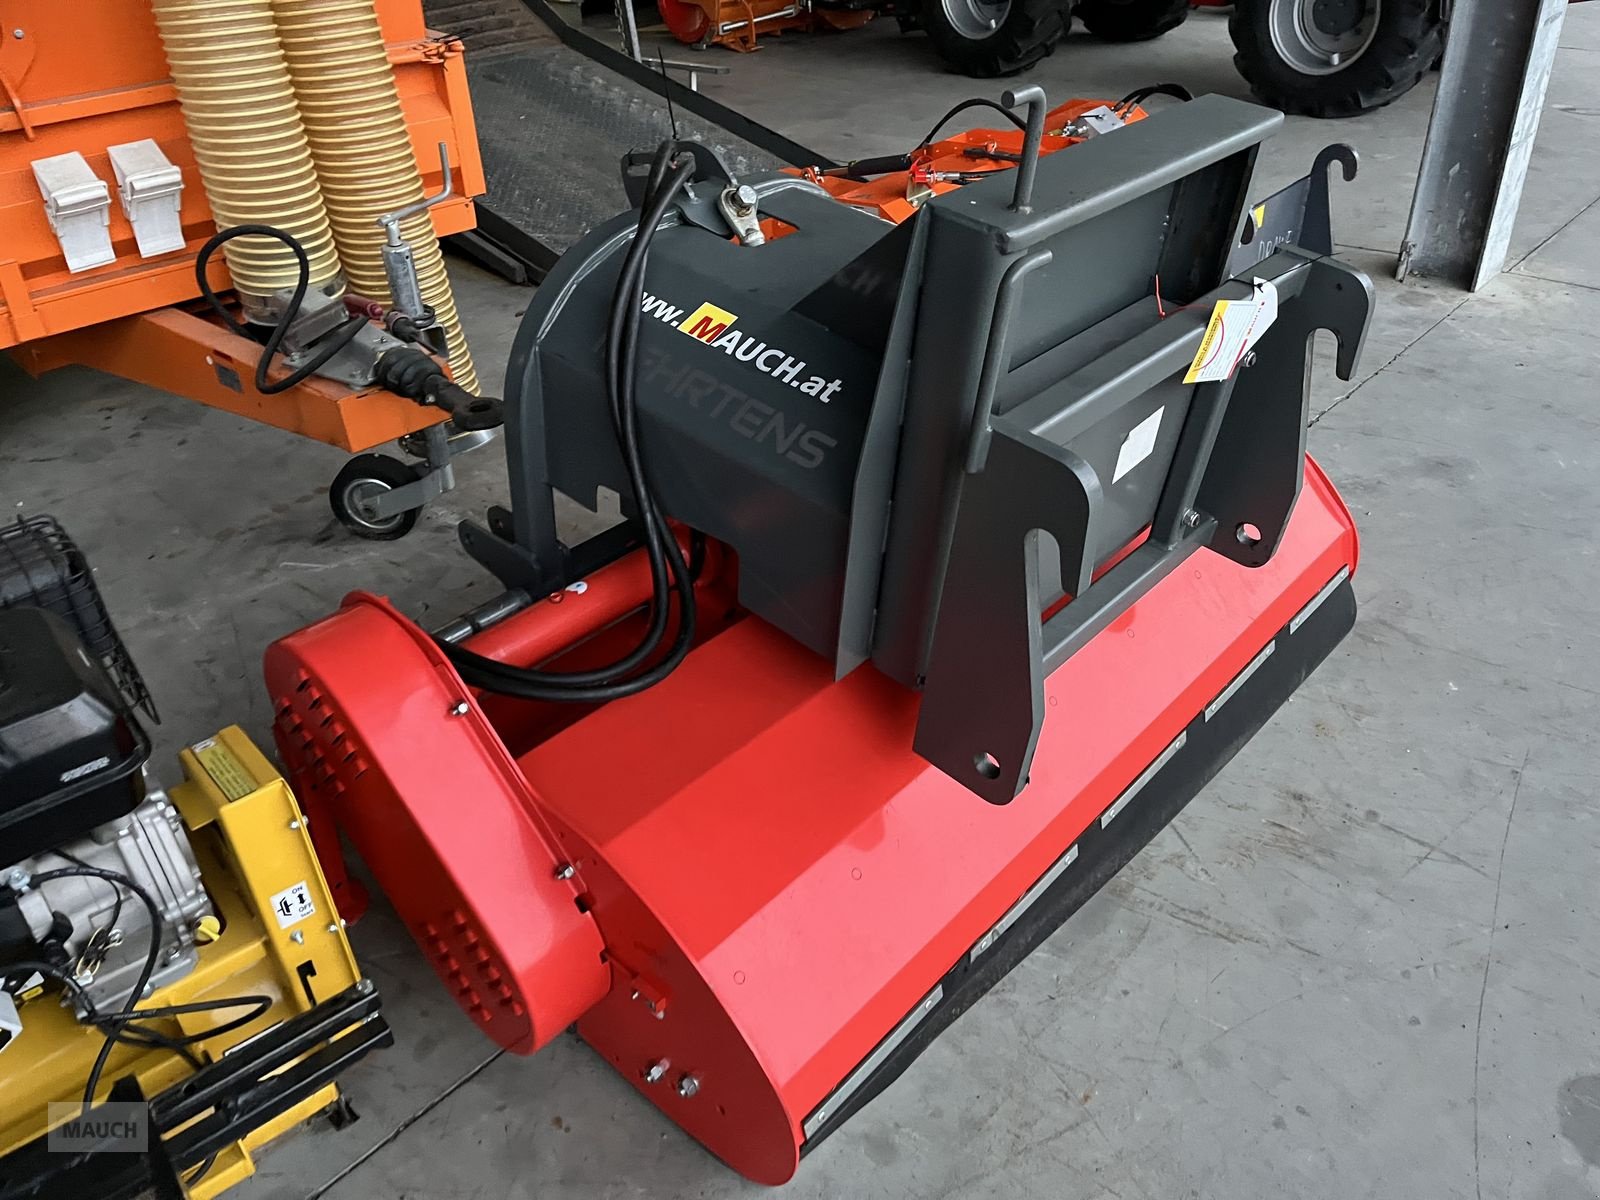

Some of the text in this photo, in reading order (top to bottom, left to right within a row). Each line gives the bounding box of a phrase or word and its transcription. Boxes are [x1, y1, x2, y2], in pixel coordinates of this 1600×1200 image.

[641, 291, 842, 404] ww.MAUCH.at
[640, 346, 838, 470] HRTENS
[292, 886, 303, 894] ON
[299, 903, 312, 912] OFF
